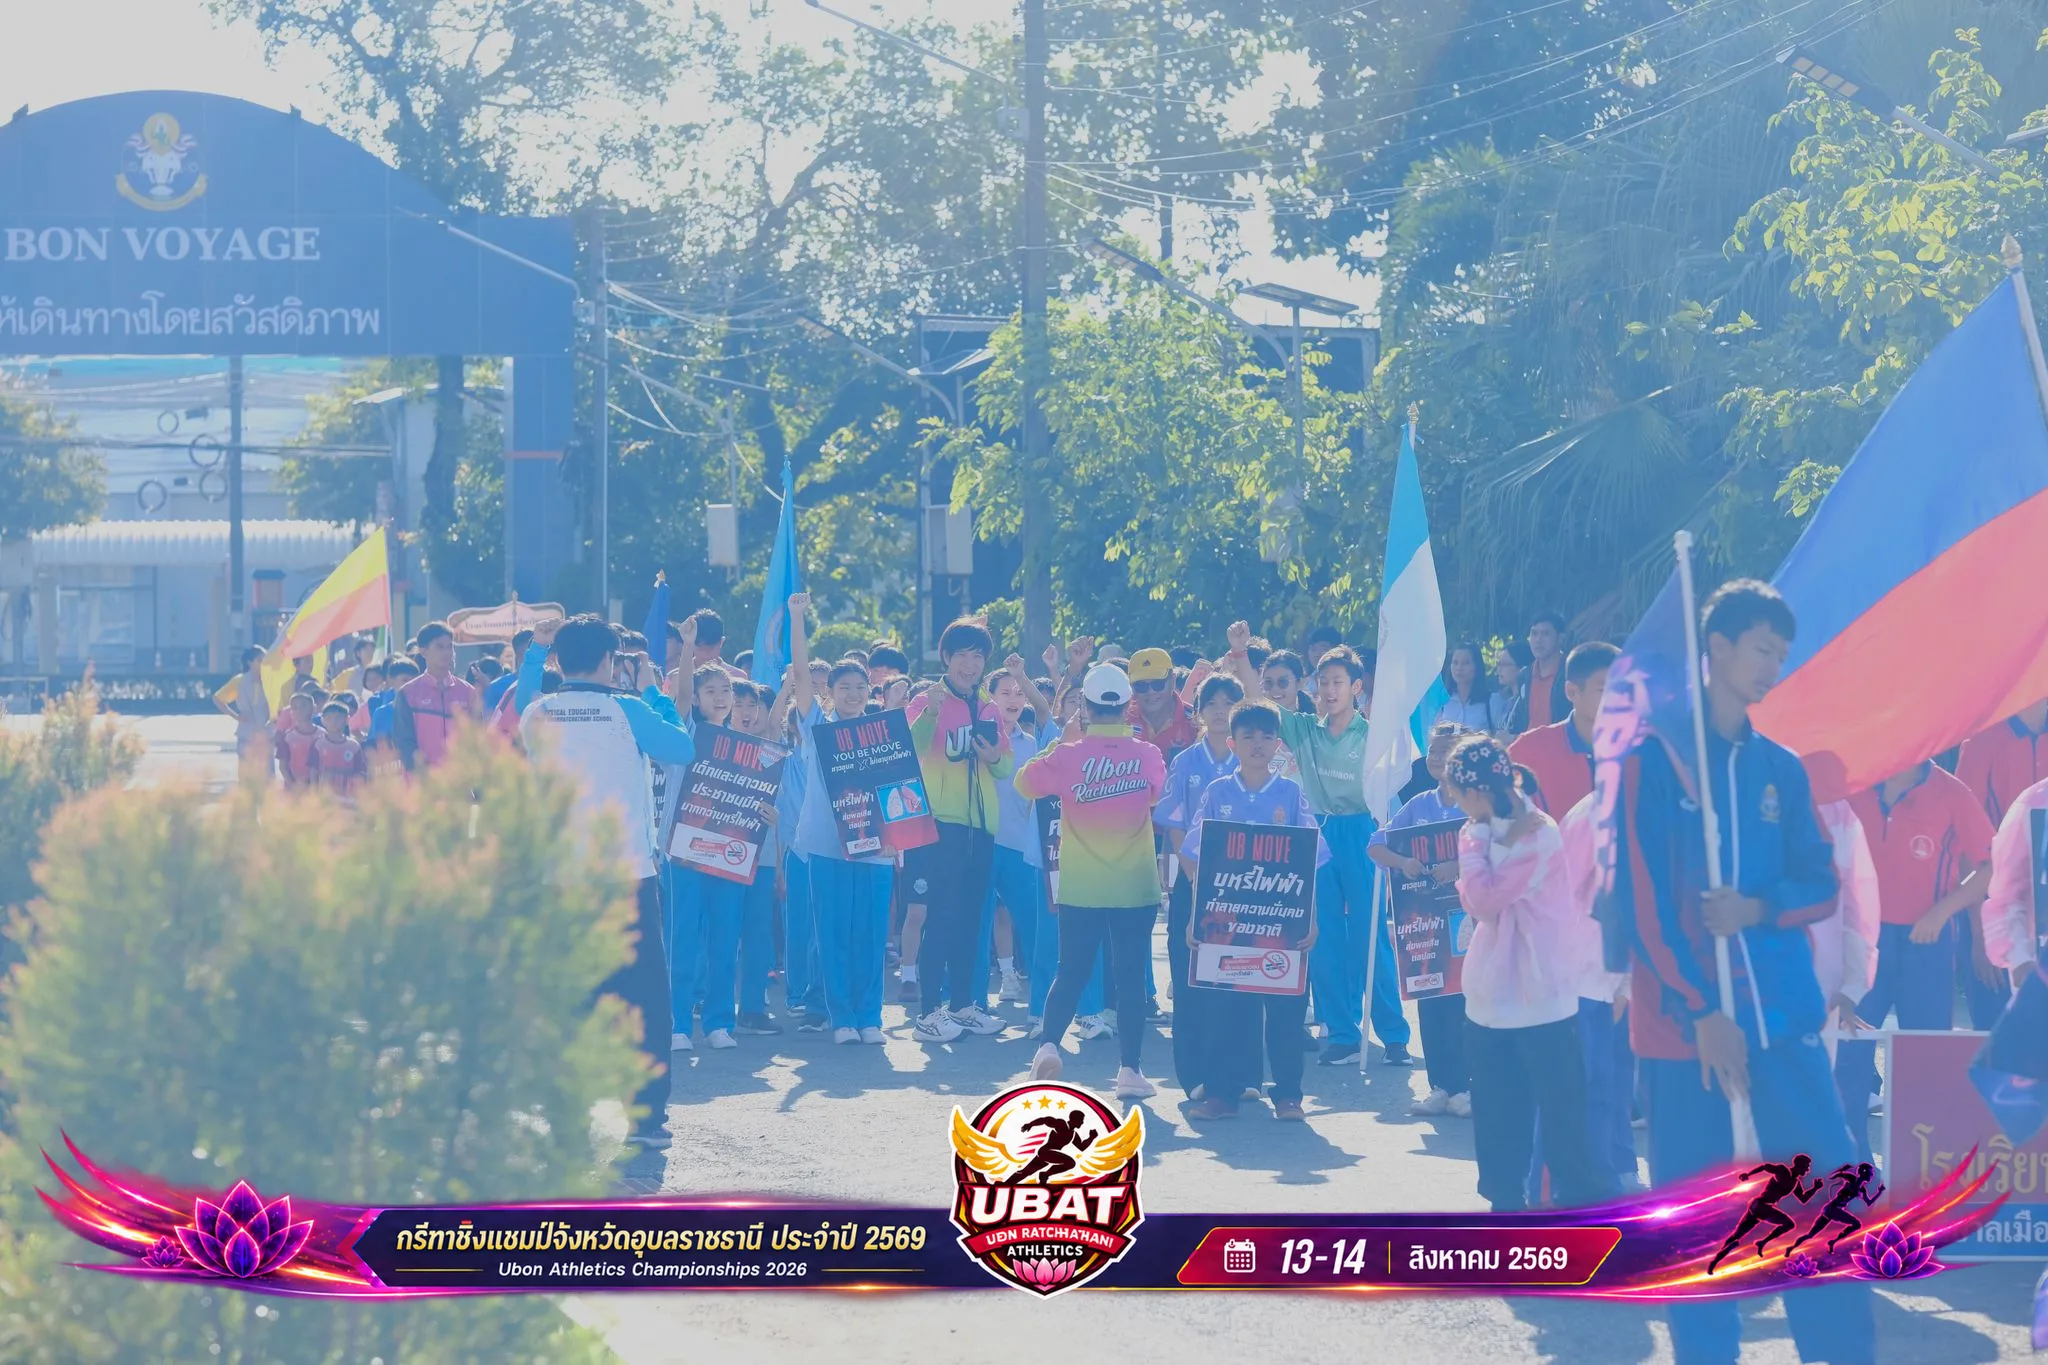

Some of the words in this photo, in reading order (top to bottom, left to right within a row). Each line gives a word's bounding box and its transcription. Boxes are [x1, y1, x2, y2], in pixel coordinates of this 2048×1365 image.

[4, 227, 110, 262] BON
[122, 226, 321, 262] VOYAGE
[712, 734, 731, 761] UB
[835, 727, 854, 752] UB
[856, 720, 892, 749] MOVE
[832, 750, 856, 763] YOU
[856, 748, 870, 758] BE
[871, 741, 902, 755] MOVE
[692, 760, 778, 796] เด็กและเยาวชน
[1081, 755, 1142, 786] Ubon
[1226, 831, 1247, 861] UB
[1252, 833, 1293, 864] MOVE
[1205, 897, 1305, 919] ทำลายความมั่นคง
[1227, 921, 1283, 938] ของชาติ
